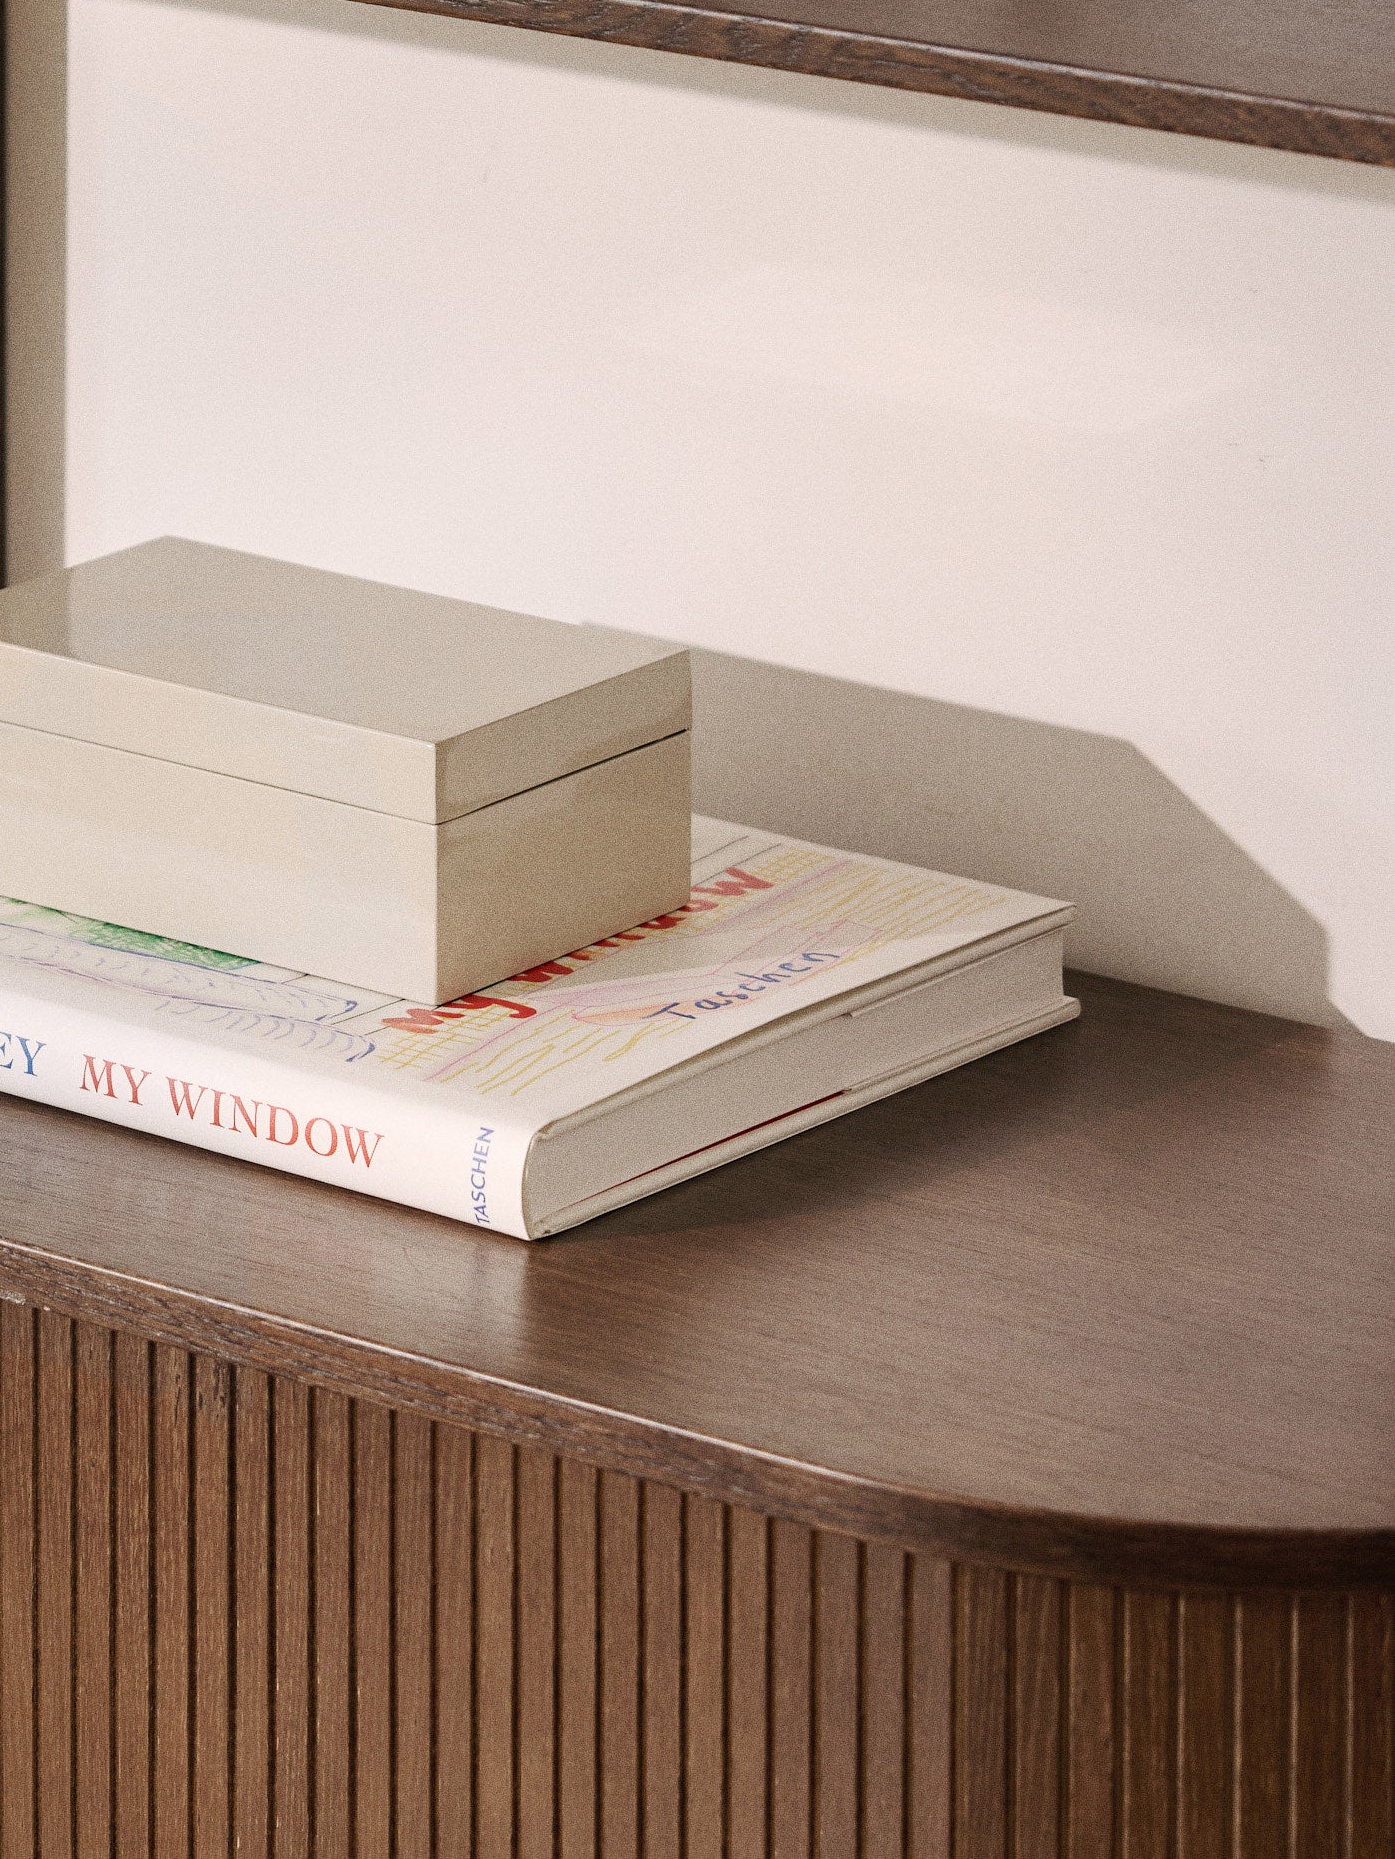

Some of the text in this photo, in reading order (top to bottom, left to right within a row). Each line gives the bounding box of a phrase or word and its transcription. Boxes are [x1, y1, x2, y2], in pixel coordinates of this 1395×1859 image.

[642, 948, 841, 1020] Taschen
[79, 1054, 152, 1106] MY
[166, 1076, 386, 1169] WINDOW
[470, 1126, 494, 1224] TASCHEN
